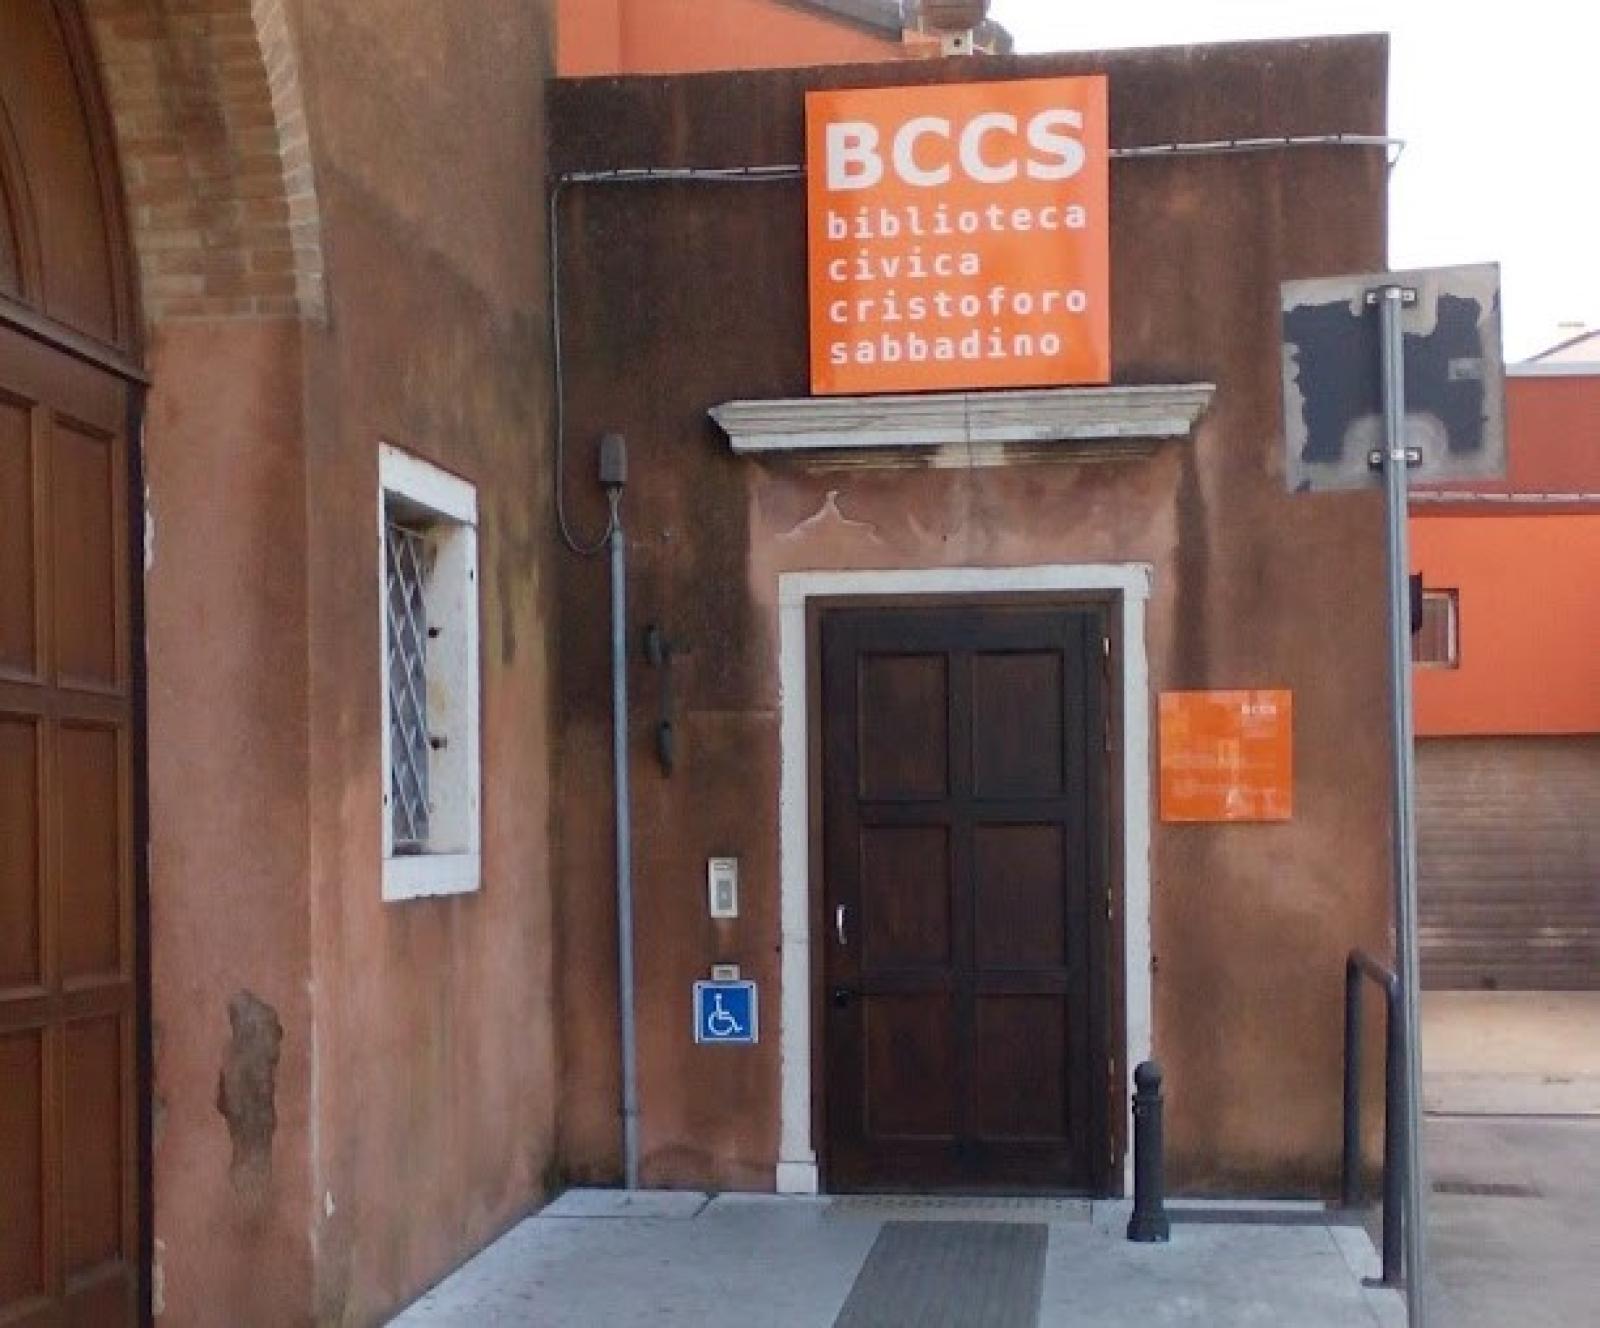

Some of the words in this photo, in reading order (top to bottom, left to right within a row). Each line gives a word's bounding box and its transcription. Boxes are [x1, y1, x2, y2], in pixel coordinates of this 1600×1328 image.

[826, 109, 1085, 191] BCCS
[828, 204, 1086, 240] biblioteca
[828, 247, 981, 280] civica
[829, 287, 1086, 322] cristoforo
[830, 327, 1061, 364] sabbadino
